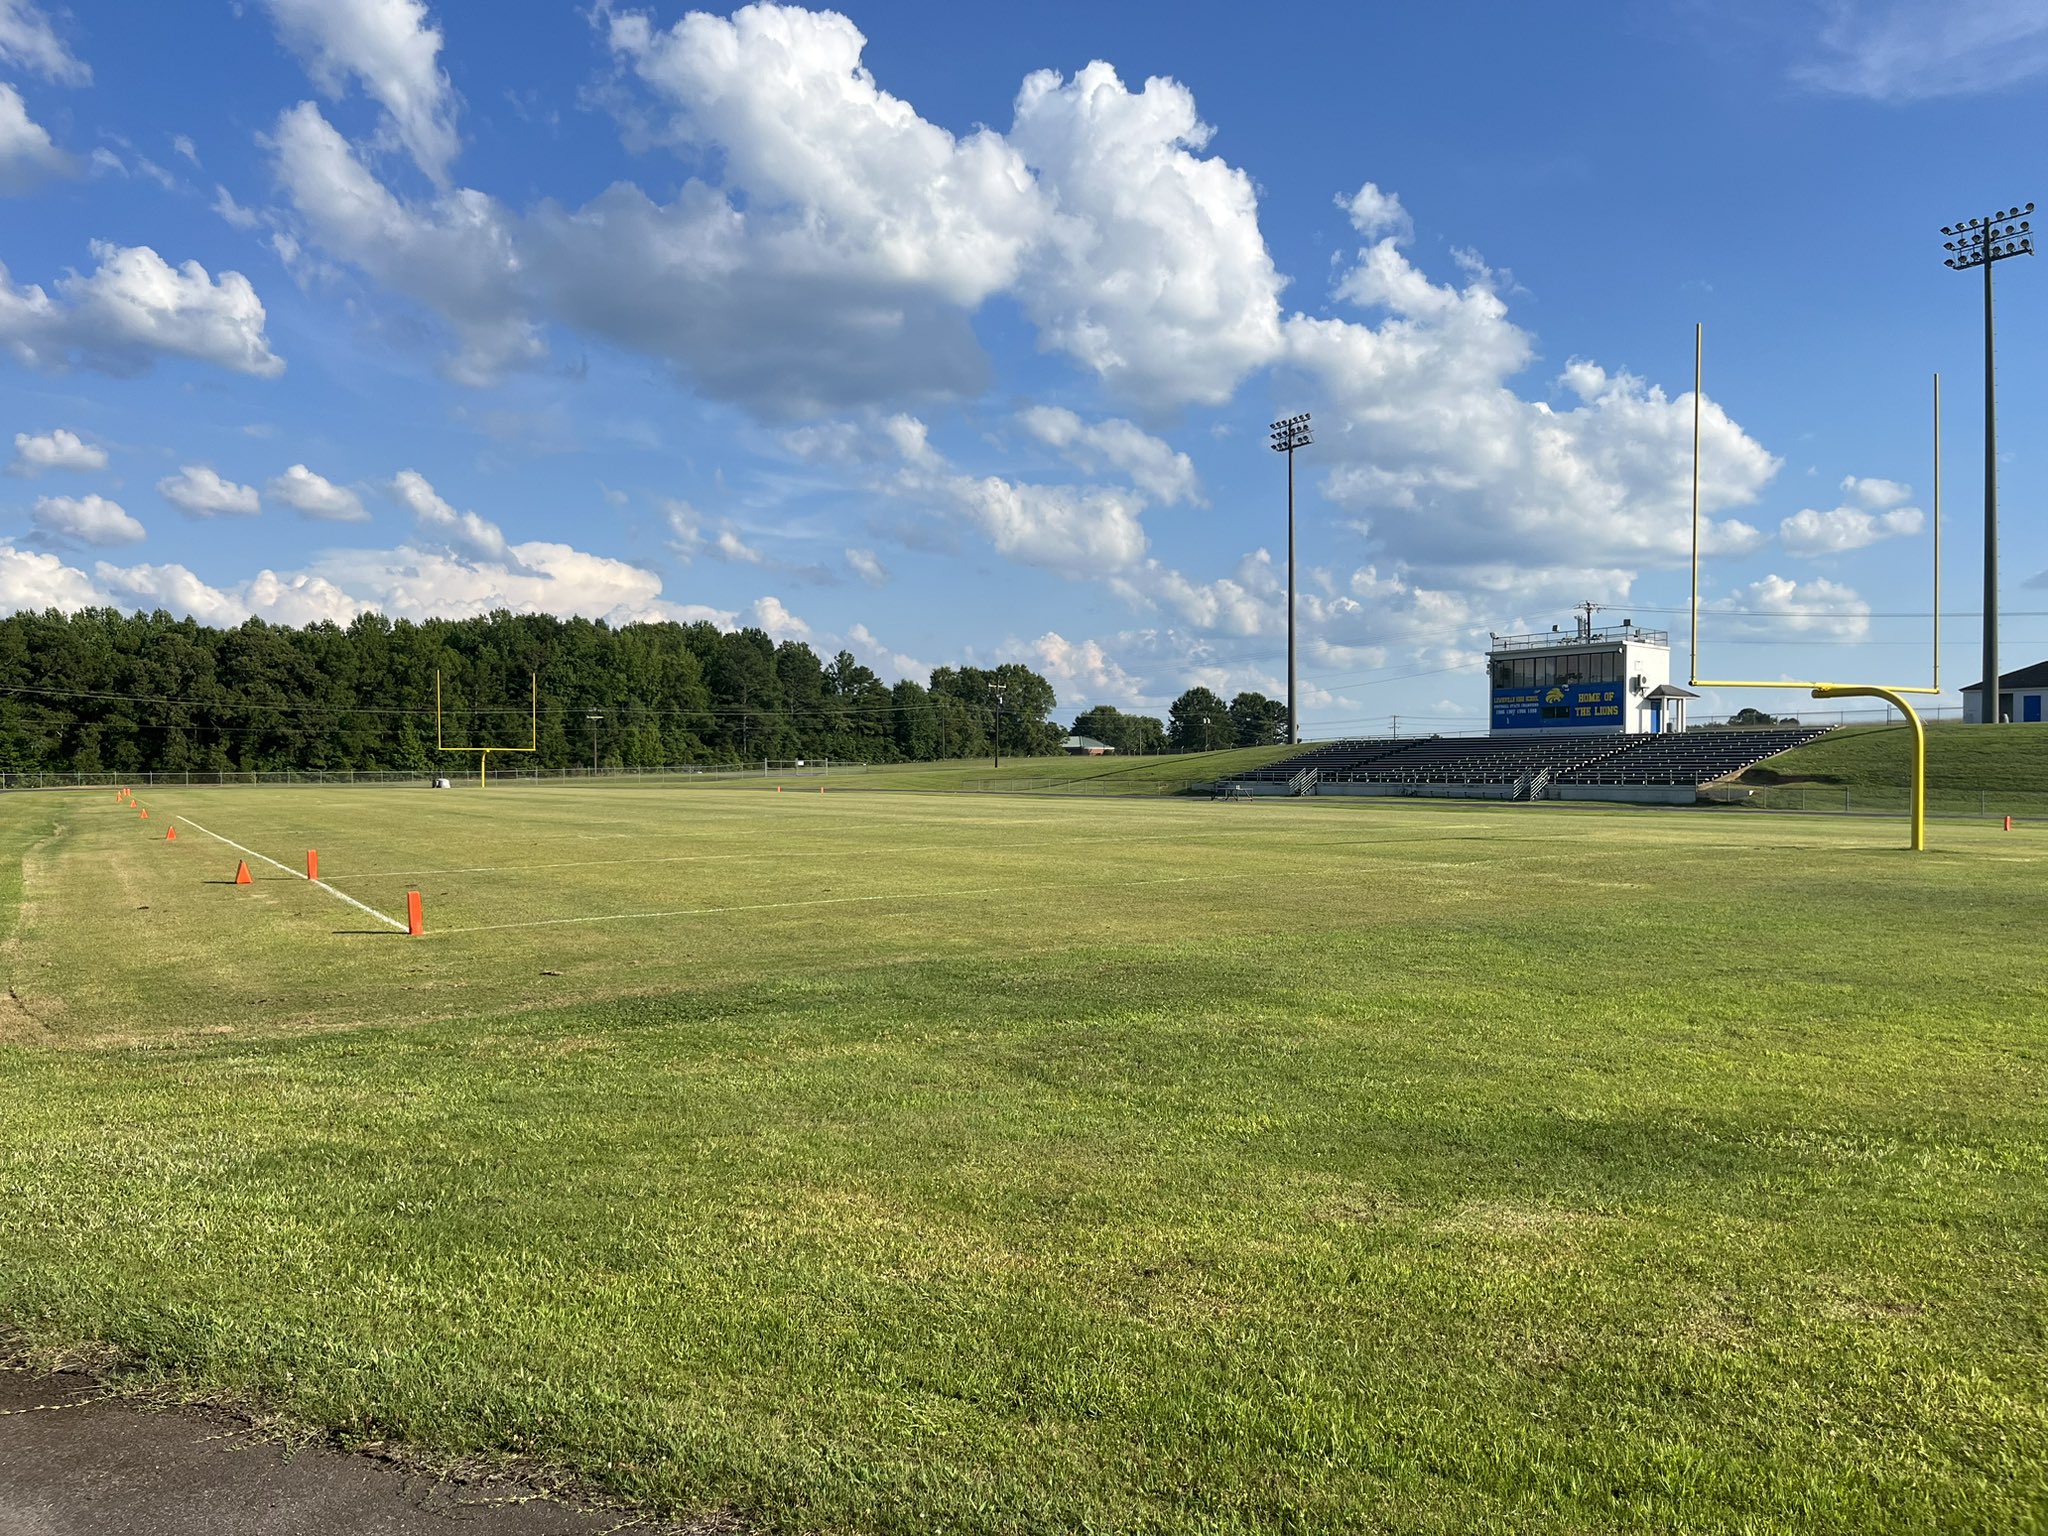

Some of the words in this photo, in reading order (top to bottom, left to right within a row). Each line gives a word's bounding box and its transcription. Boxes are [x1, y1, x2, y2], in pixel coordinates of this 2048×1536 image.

[1578, 693, 1600, 702] HOME
[1604, 692, 1614, 701] OF
[1575, 707, 1591, 716] THE
[1594, 706, 1618, 715] LIONS
